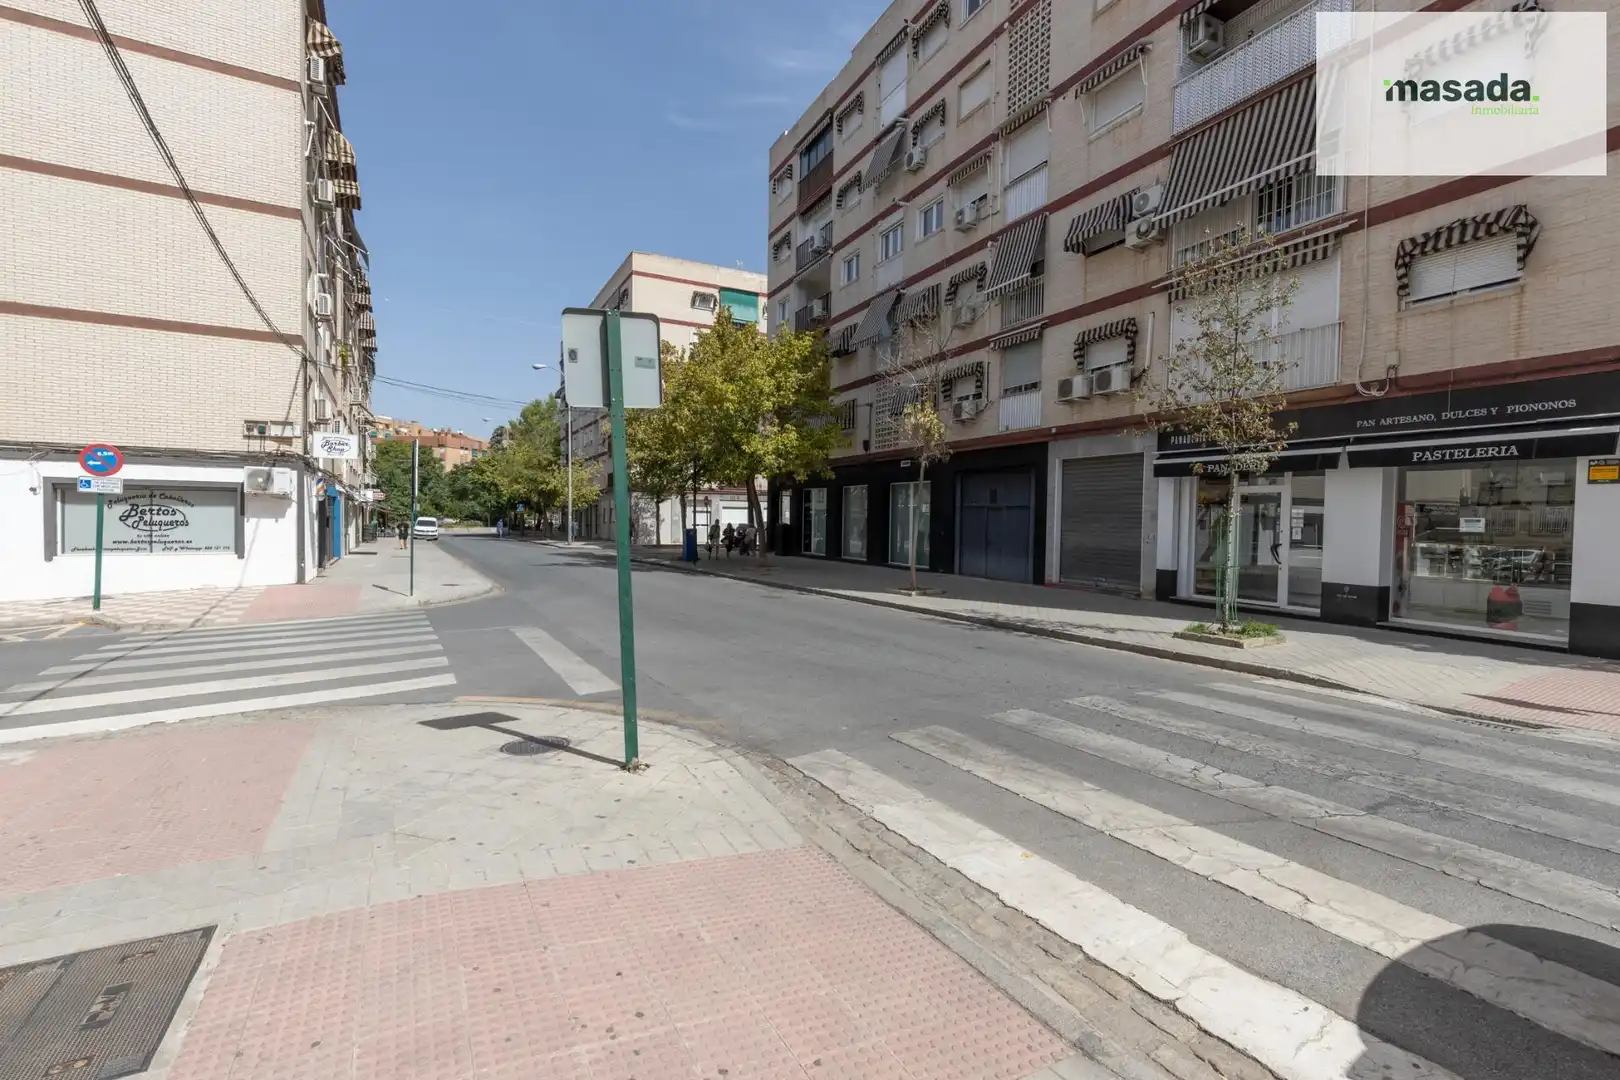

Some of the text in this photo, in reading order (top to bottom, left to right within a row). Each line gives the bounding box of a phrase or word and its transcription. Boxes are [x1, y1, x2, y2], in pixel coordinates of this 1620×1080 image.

[1356, 419, 1376, 428] PAN
[1441, 407, 1487, 420] DULCES
[1490, 407, 1499, 415] Y
[1506, 399, 1577, 414] PIONONOS
[1412, 445, 1519, 461] PASTELERIA
[119, 503, 177, 522] Bertos
[131, 515, 189, 532] Peluqueros
